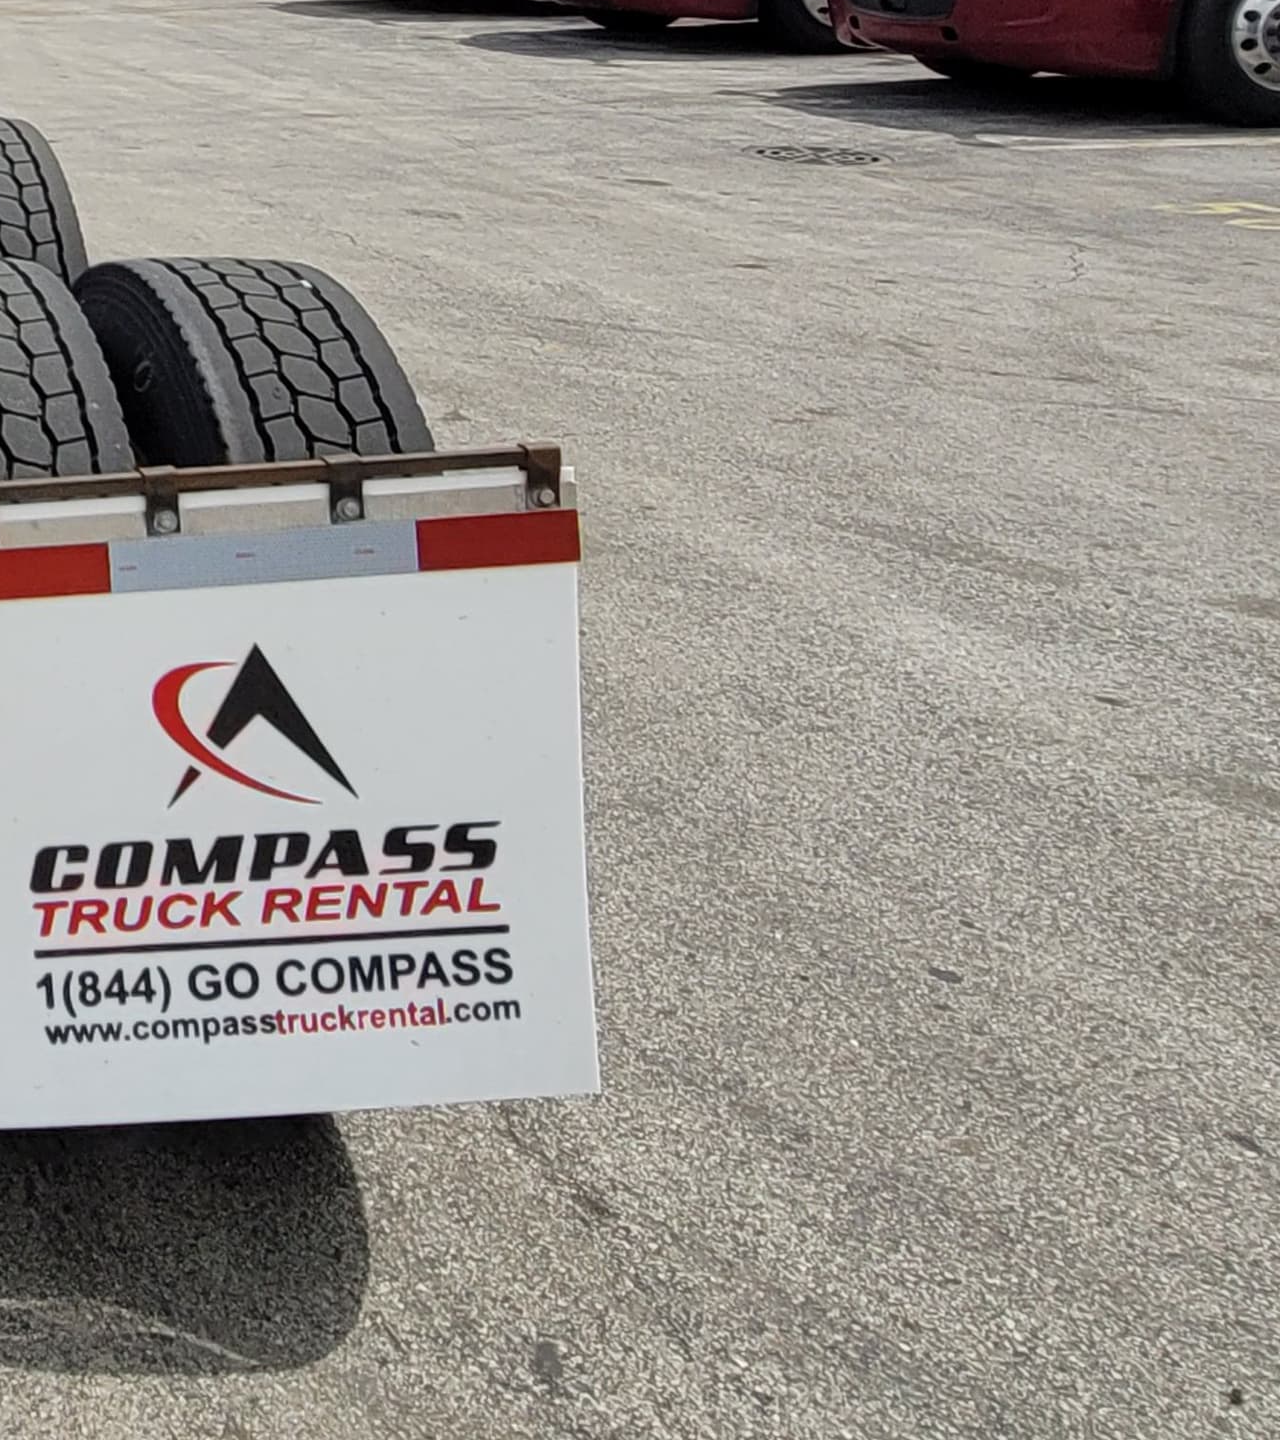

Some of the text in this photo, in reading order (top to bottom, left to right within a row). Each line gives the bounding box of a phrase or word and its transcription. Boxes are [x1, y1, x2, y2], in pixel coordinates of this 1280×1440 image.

[28, 820, 503, 894] COMPASS
[31, 876, 502, 938] TRUCK RENTAL
[35, 947, 514, 1019] 1(844) GO COMPASS
[44, 996, 522, 1045] www.compasstruckrental.com
